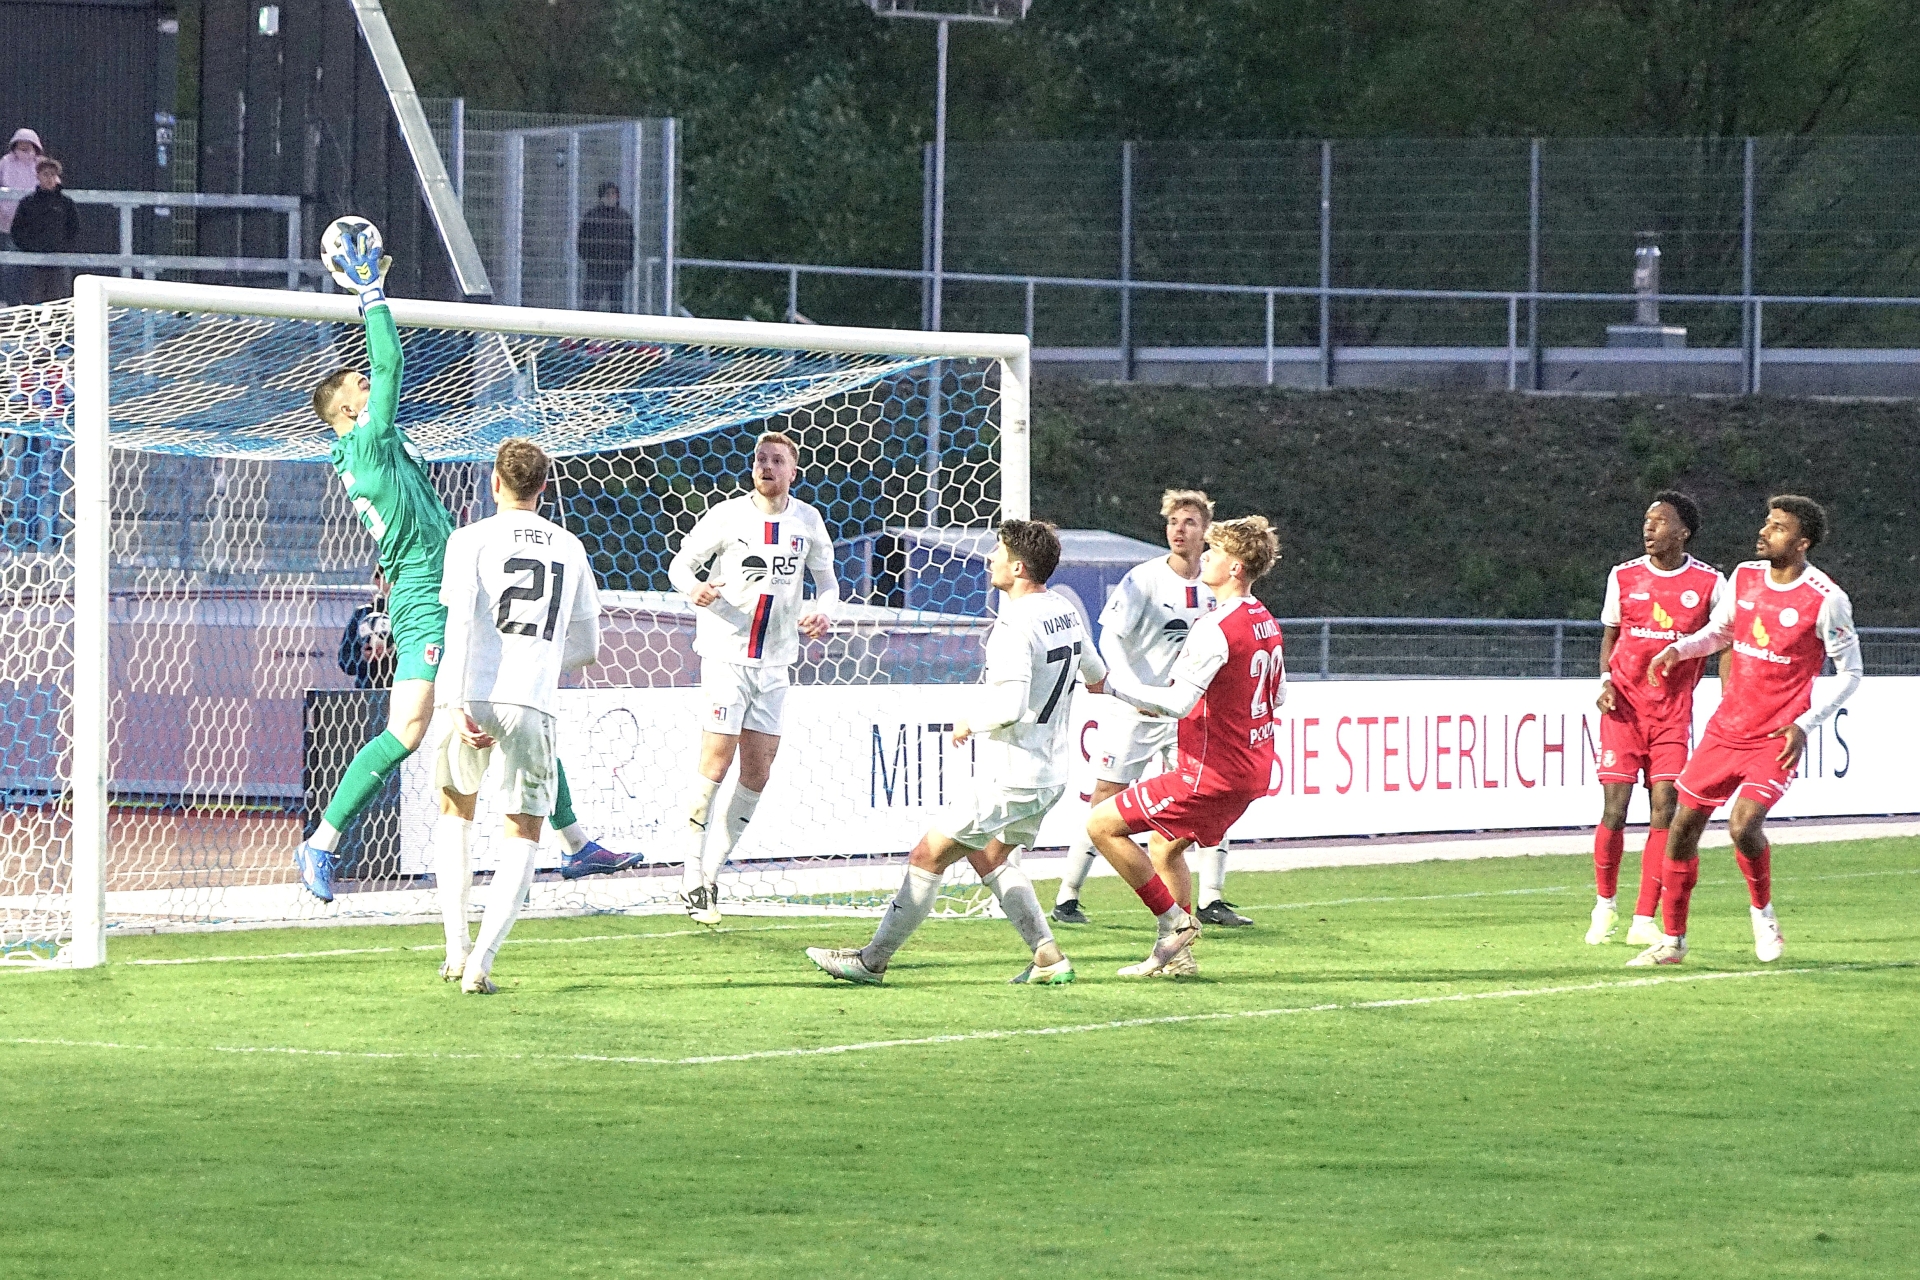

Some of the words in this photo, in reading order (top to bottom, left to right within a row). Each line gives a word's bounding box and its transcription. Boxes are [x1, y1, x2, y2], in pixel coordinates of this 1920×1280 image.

[513, 529, 553, 546] FREY
[496, 557, 565, 642] 21
[871, 723, 955, 808] MIT
[1335, 713, 1565, 795] STEUERLICH
